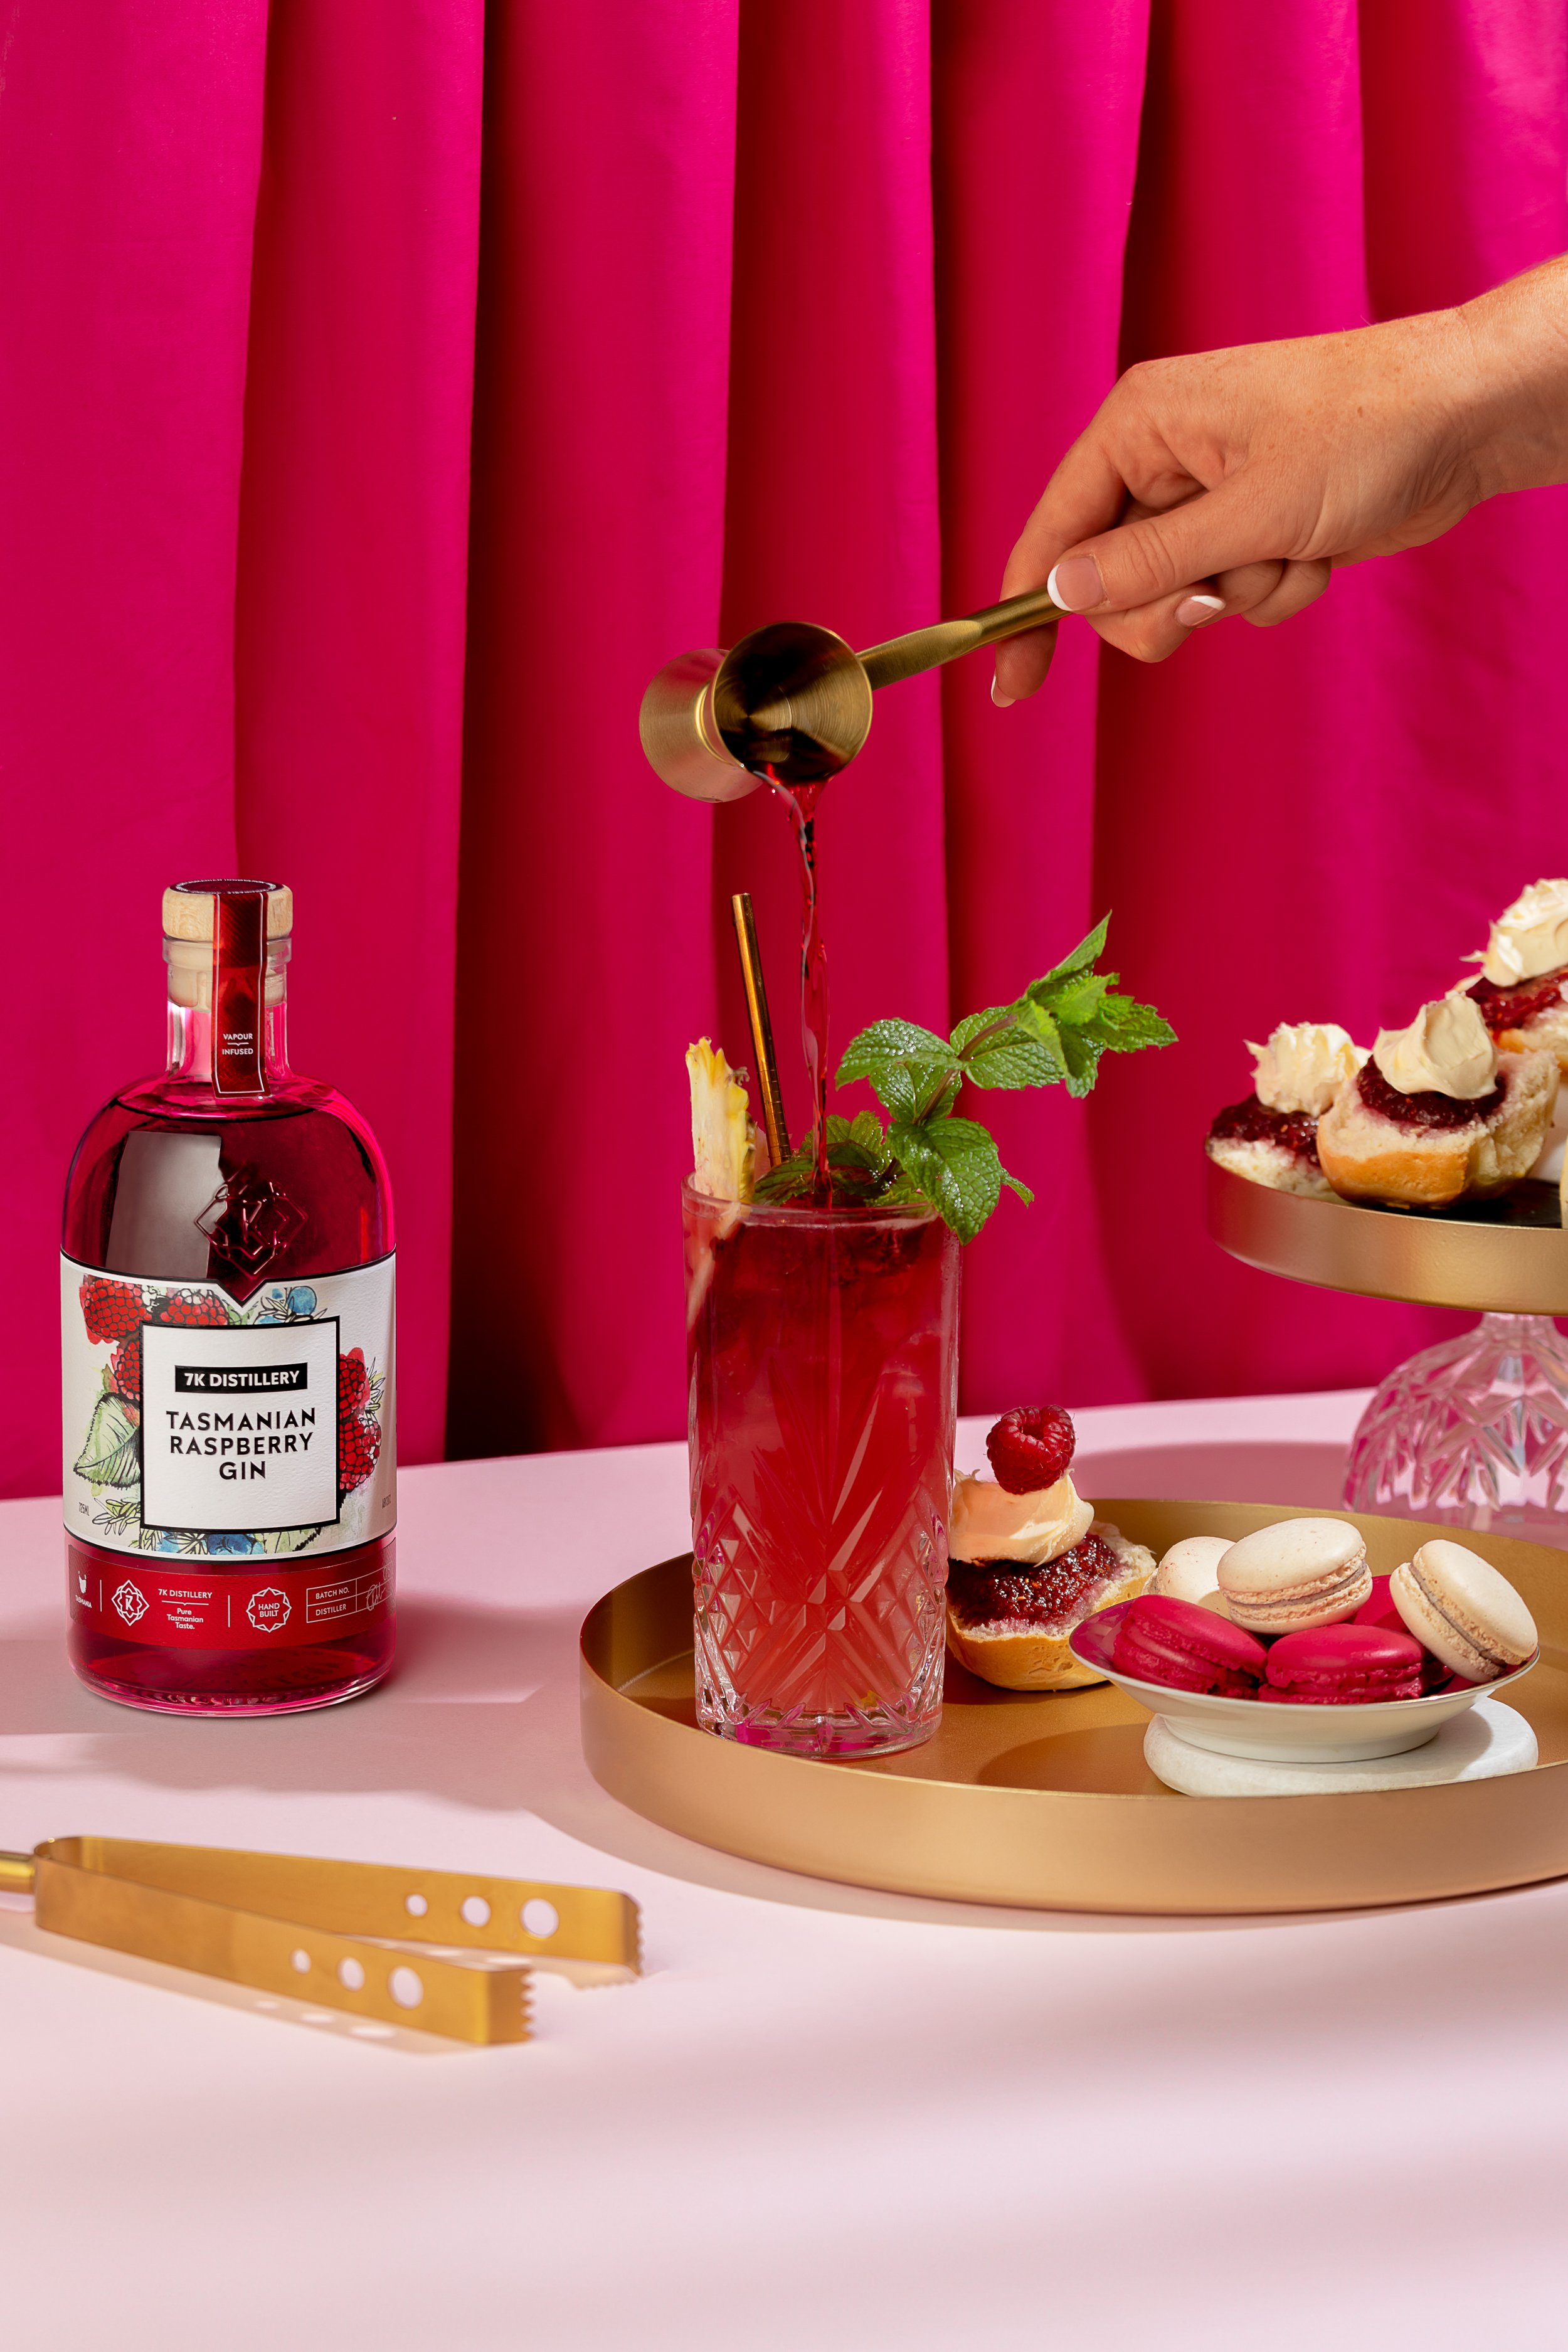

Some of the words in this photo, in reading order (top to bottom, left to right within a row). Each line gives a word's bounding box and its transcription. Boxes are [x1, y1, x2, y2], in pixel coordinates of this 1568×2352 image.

[184, 1373, 205, 1386] 7K
[209, 1370, 300, 1387] DISTILLERY
[166, 1407, 315, 1431] TASMANIAN
[170, 1432, 314, 1455] RASPBERRY
[219, 1461, 266, 1480] GIN
[169, 1589, 213, 1599] DISTILLERY
[315, 1589, 337, 1599] BATCH
[338, 1587, 349, 1595] NO.
[75, 1594, 92, 1608] TASMANIA
[258, 1602, 280, 1611] HAND
[177, 1608, 192, 1616] Pure
[315, 1604, 346, 1616] DISTILLER
[166, 1614, 204, 1623] Tasmanian
